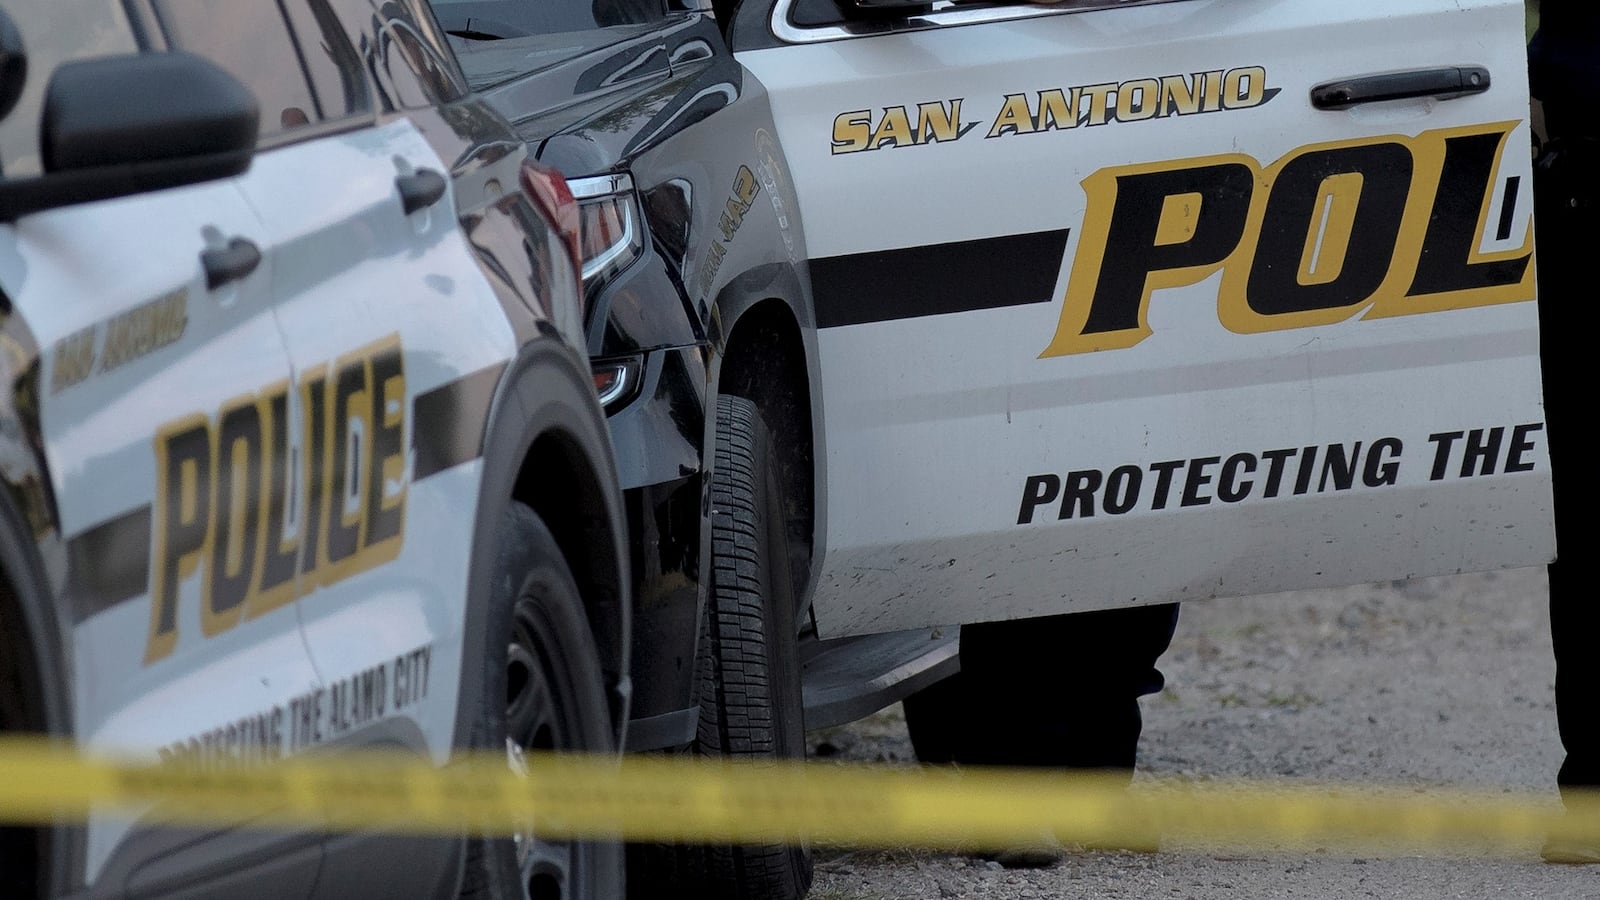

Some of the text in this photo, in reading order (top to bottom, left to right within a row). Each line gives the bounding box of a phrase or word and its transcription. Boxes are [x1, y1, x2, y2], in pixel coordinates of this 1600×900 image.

[831, 66, 1282, 155] SAN ANTONIO
[142, 331, 407, 667] POLICE
[1017, 422, 1544, 525] PROTECTING THE
